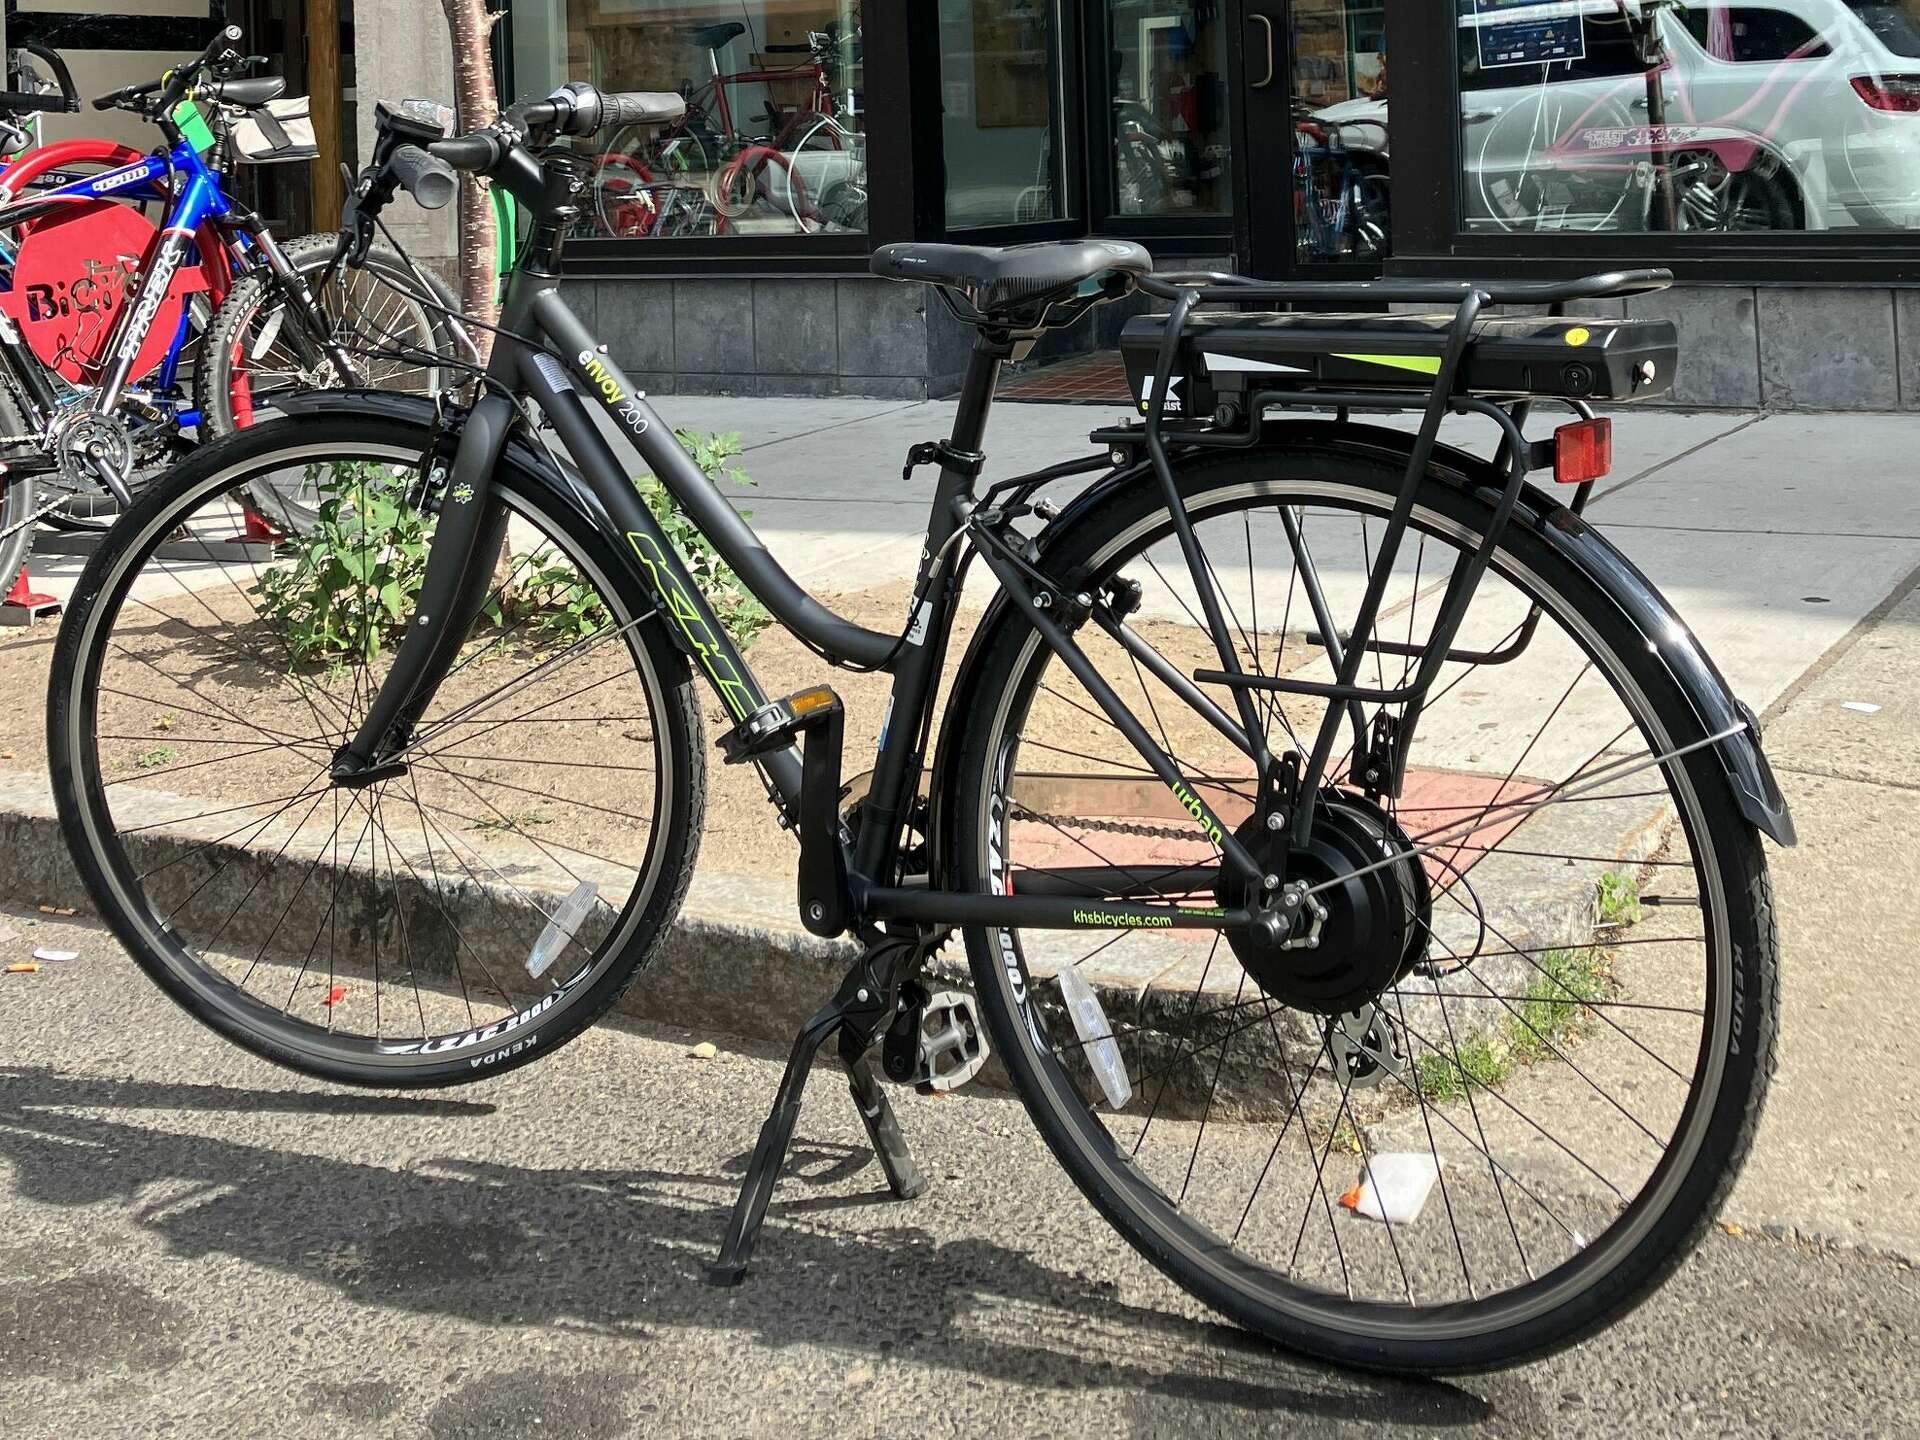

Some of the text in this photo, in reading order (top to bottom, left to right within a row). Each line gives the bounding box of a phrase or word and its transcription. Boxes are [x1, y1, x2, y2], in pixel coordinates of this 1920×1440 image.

[118, 241, 184, 360] TREK
[578, 350, 649, 434] envoy 200
[1172, 781, 1222, 844] urban
[1073, 910, 1173, 927] khsbicycles.com
[1730, 942, 1744, 1055] KENDA
[470, 1035, 537, 1068] KENDA
